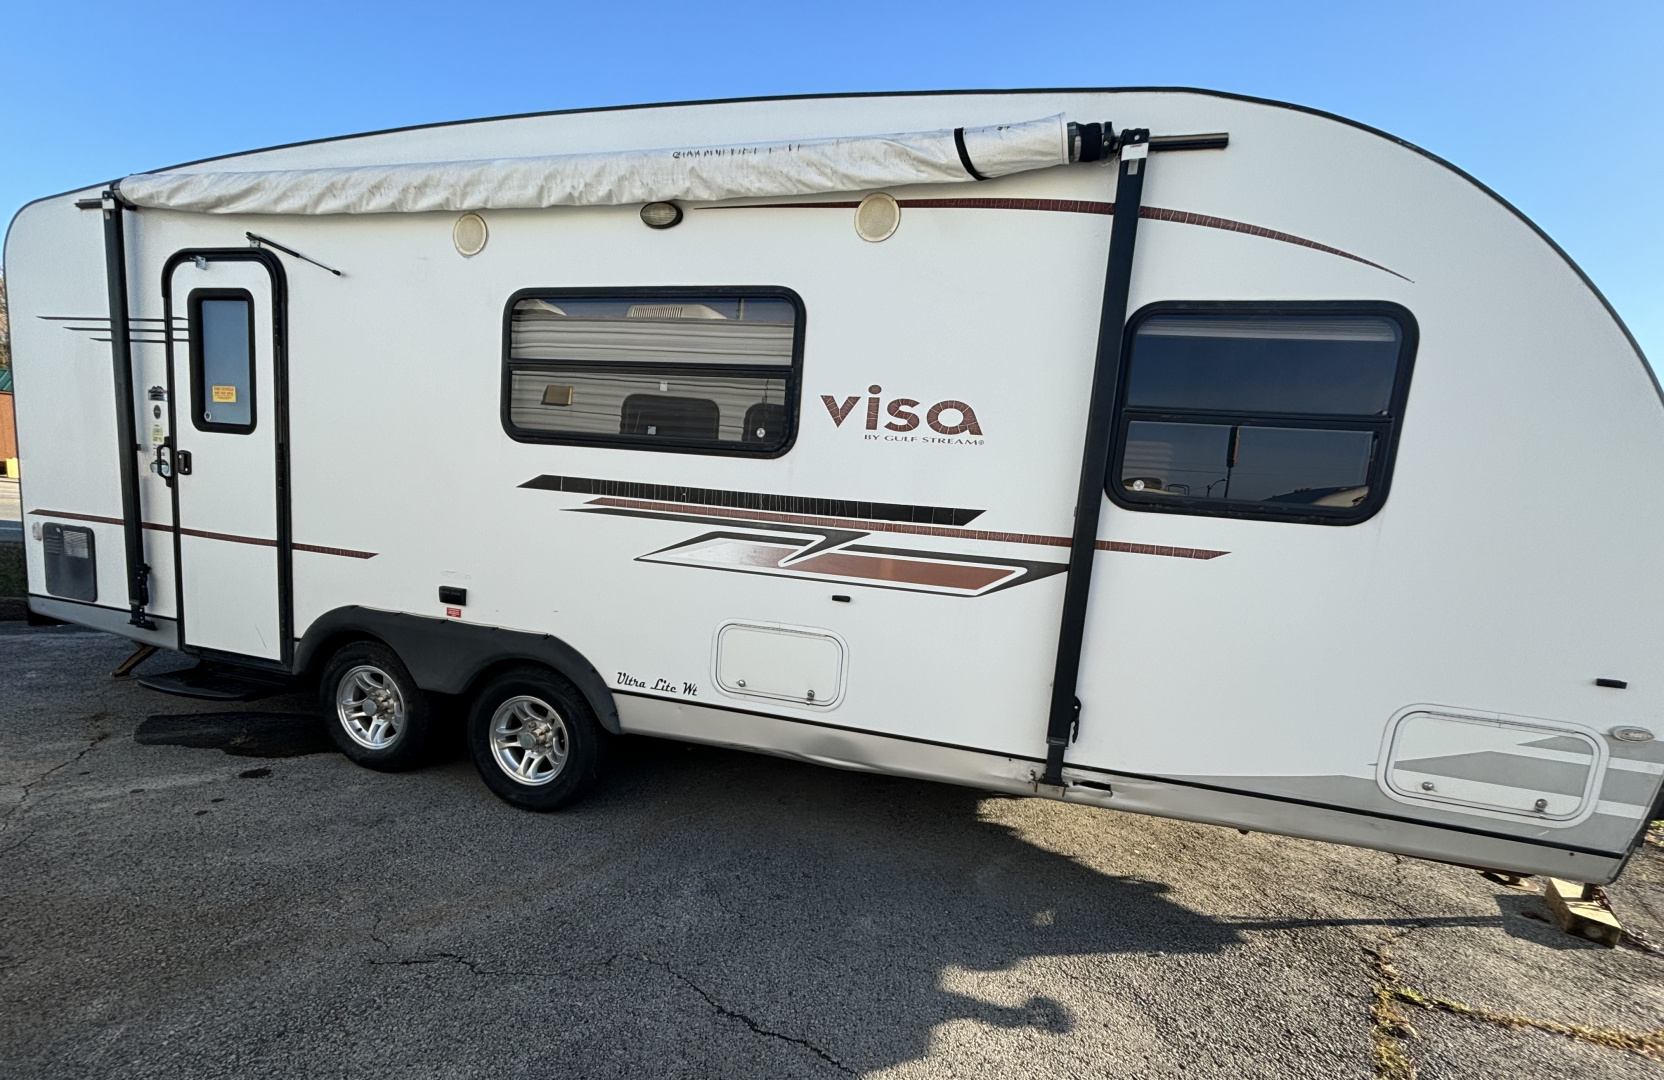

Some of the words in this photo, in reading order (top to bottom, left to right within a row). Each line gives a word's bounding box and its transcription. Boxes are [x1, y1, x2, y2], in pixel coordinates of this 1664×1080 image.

[820, 384, 983, 436] visa
[617, 671, 646, 688] Ultra
[683, 682, 698, 696] Wt
